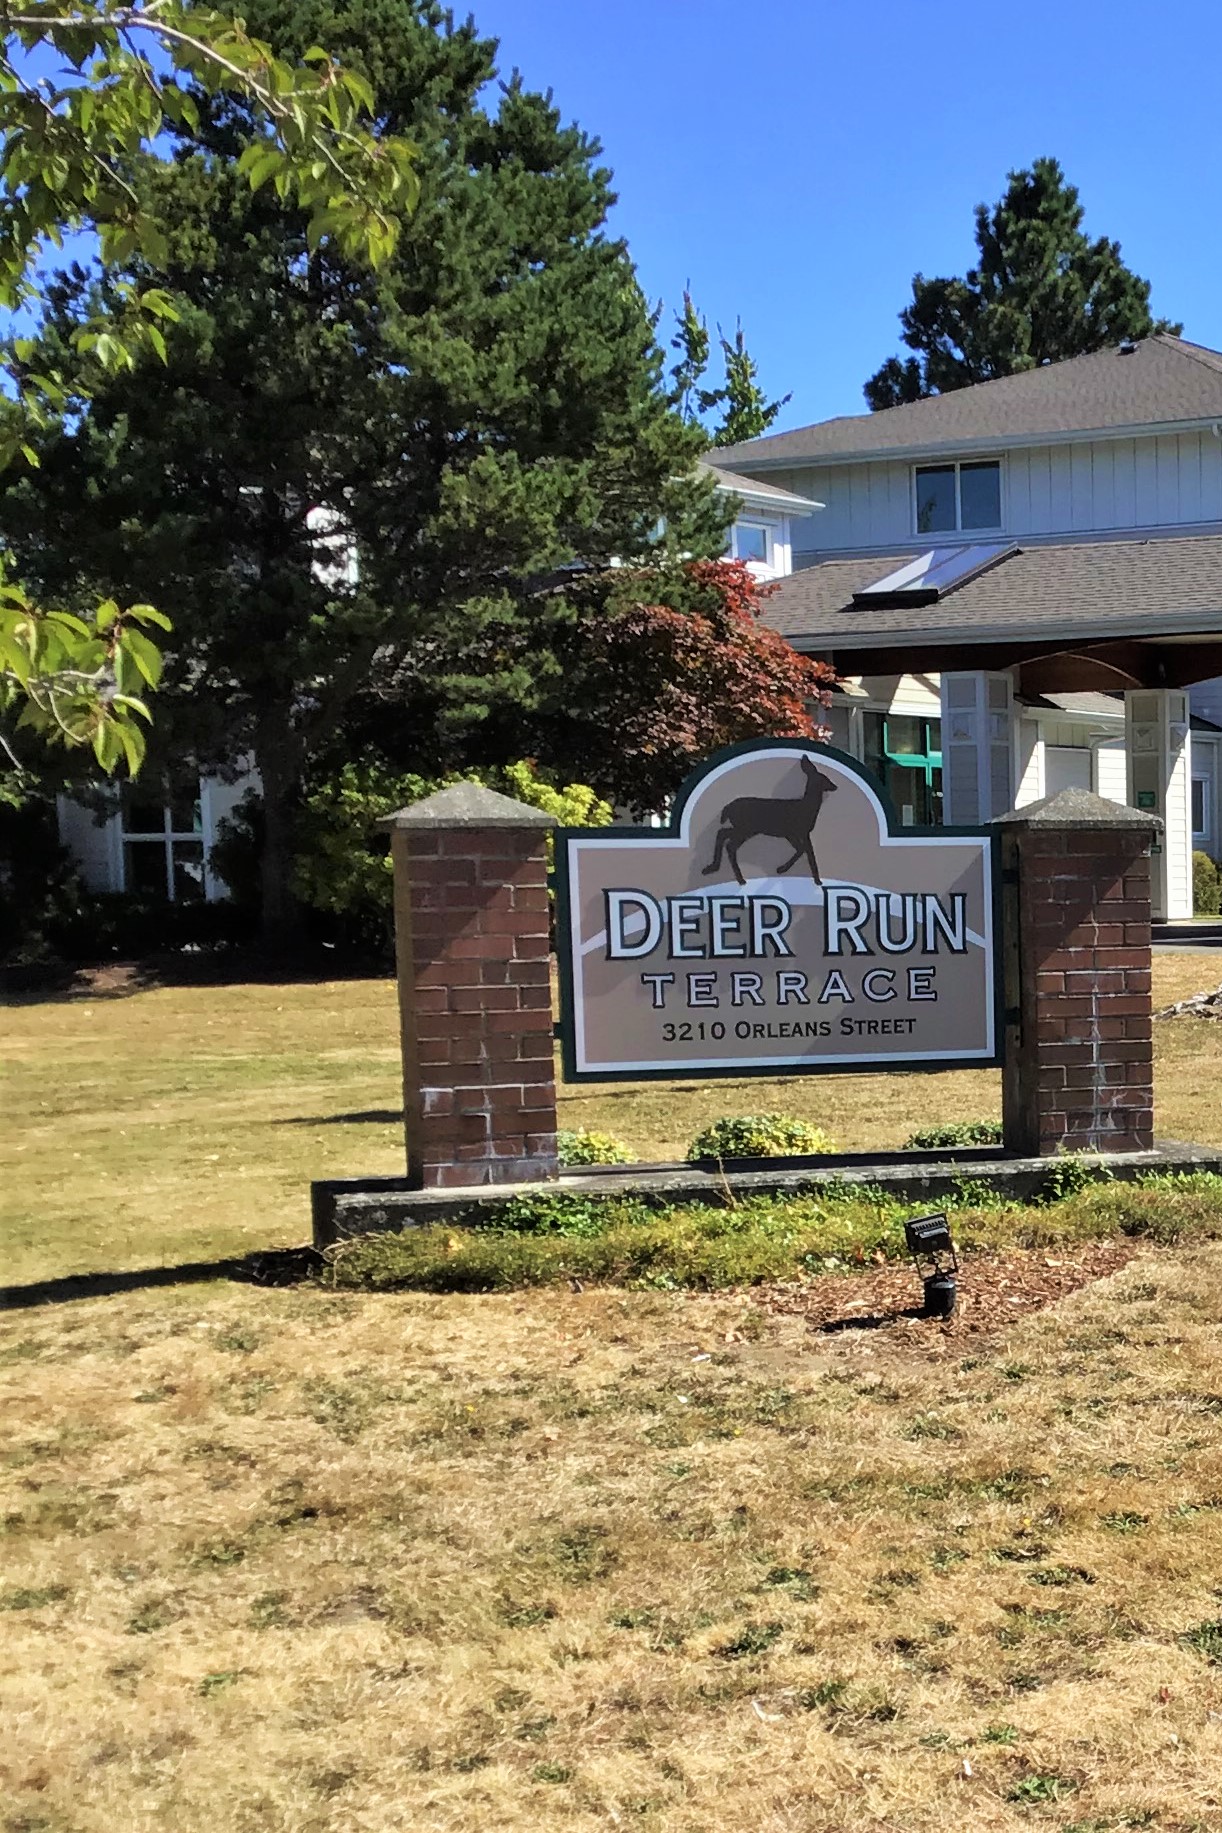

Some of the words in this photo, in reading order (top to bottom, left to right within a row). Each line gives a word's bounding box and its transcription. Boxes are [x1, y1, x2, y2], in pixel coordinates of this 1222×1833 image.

[602, 887, 796, 960] DEER
[821, 886, 968, 957] RUN
[641, 966, 938, 1009] TERRACE
[662, 1021, 727, 1042] 3210
[734, 1019, 832, 1040] ORLEANS
[839, 1016, 917, 1036] STREET
